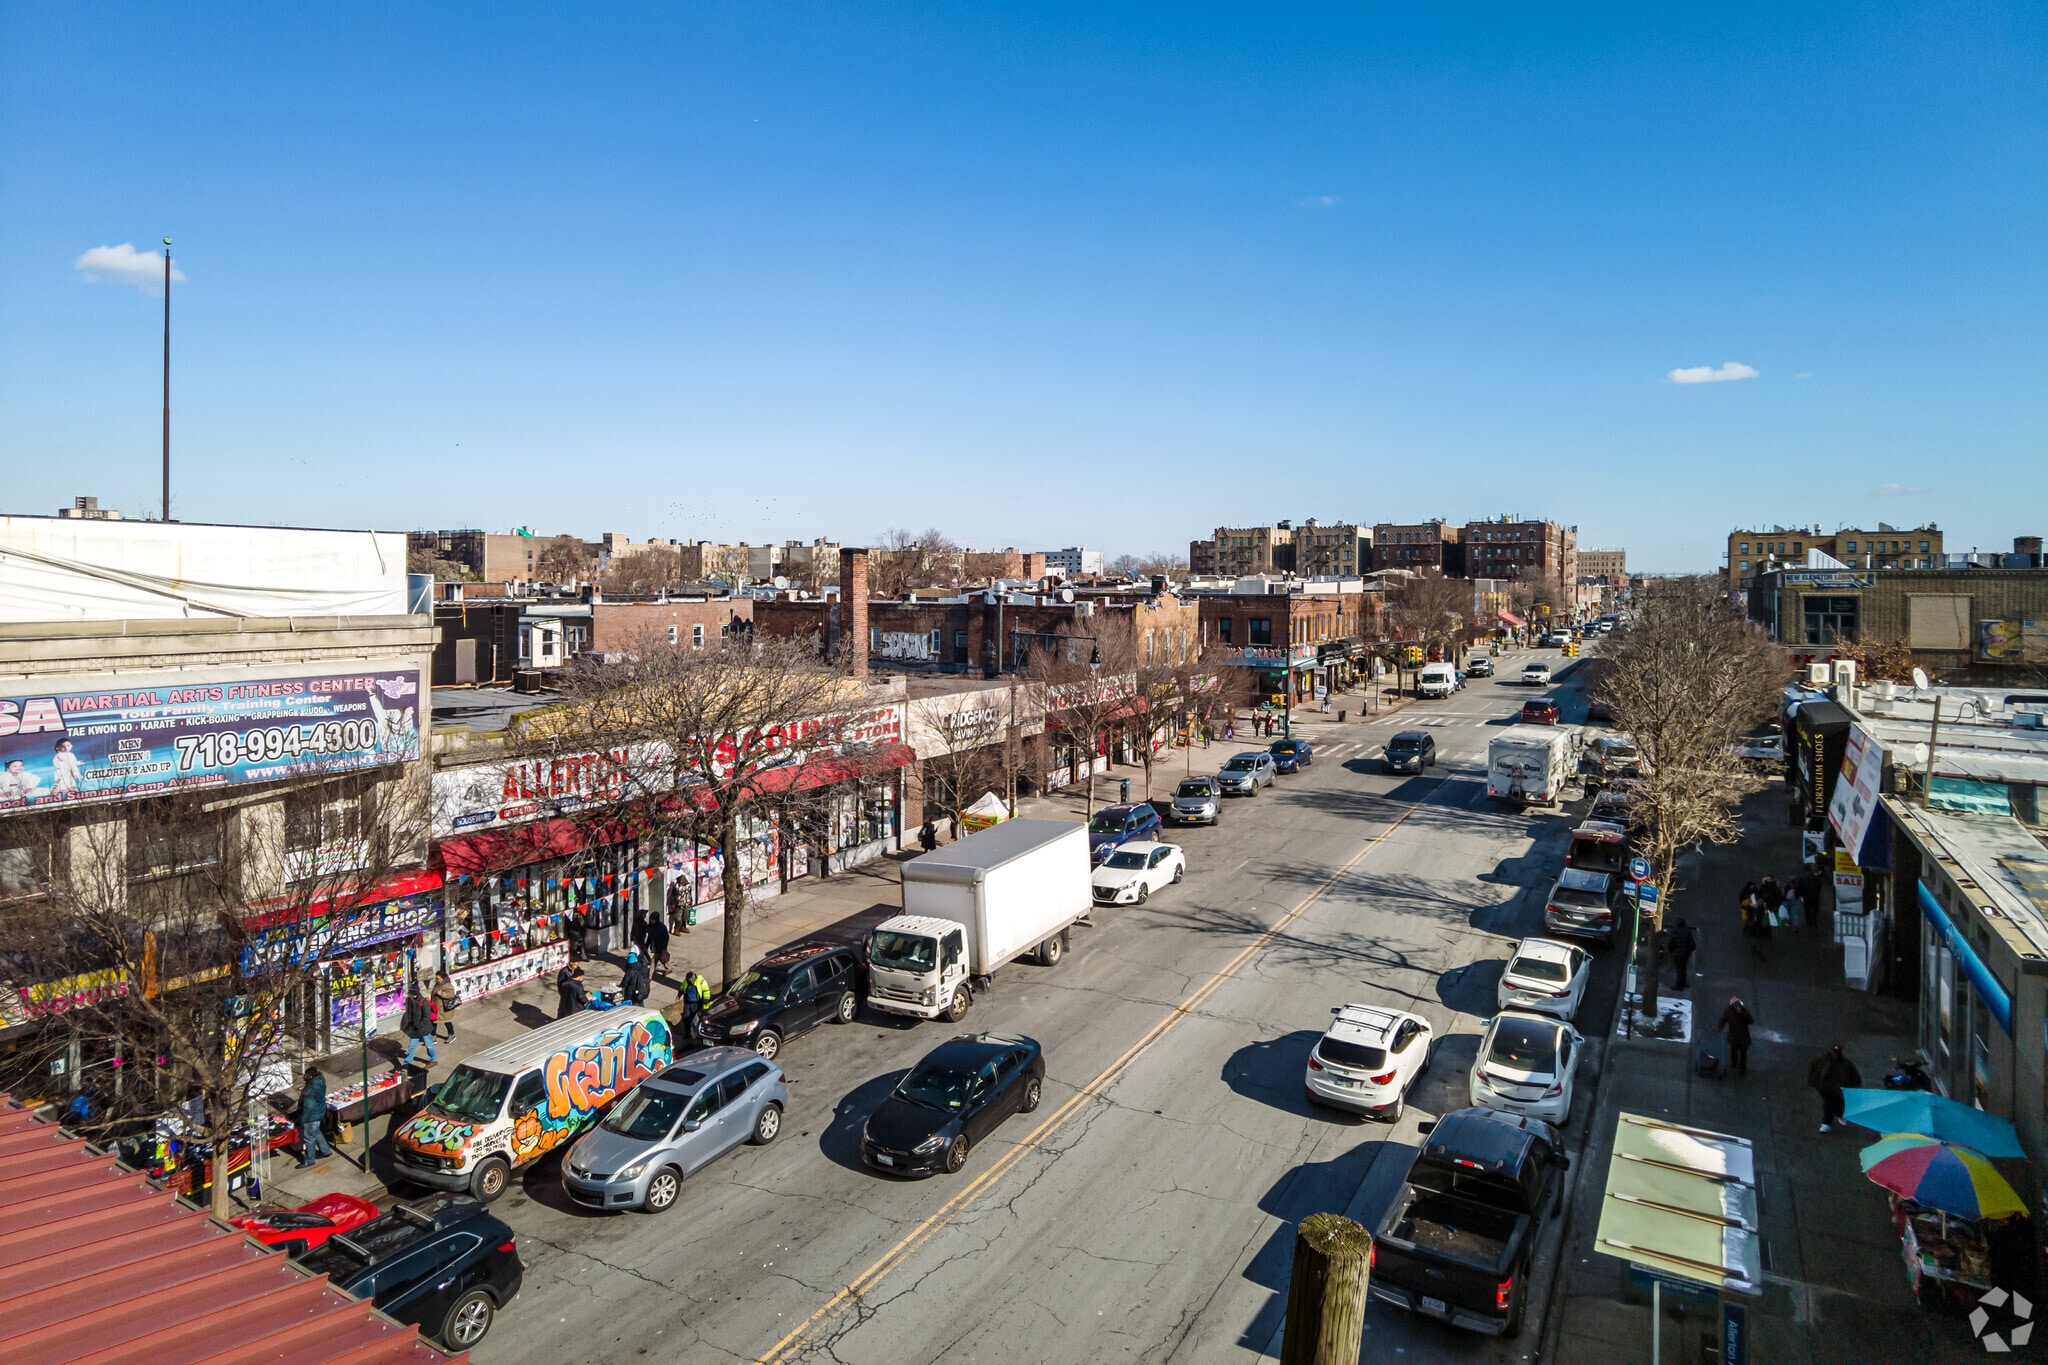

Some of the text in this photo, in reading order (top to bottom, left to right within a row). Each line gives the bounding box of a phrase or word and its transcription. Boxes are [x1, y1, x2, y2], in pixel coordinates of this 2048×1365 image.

[62, 677, 375, 712] MARTIAL ARTS FITNESS CENTER
[119, 695, 331, 719] Your Family Training Center
[67, 703, 367, 737] TAE KWON DO KARATE KICK-BOXING GRAPPLING JUDO WEAPONS
[855, 722, 900, 740] STORE
[119, 739, 141, 750] MEN
[175, 718, 377, 773] 718-994-4300
[85, 768, 131, 780] CHILDREN
[140, 765, 158, 775] AND
[160, 762, 171, 772] UP
[110, 753, 144, 765] WOMEN
[1814, 734, 1824, 813] FLORSHEIM SHOES
[35, 792, 62, 805] and
[66, 786, 123, 801] Summer
[128, 781, 164, 794] Camp
[1836, 877, 1862, 887] SALE
[383, 908, 429, 932] SHOP
[333, 974, 358, 990] ATM
[1727, 1319, 1738, 1360] Allerton
